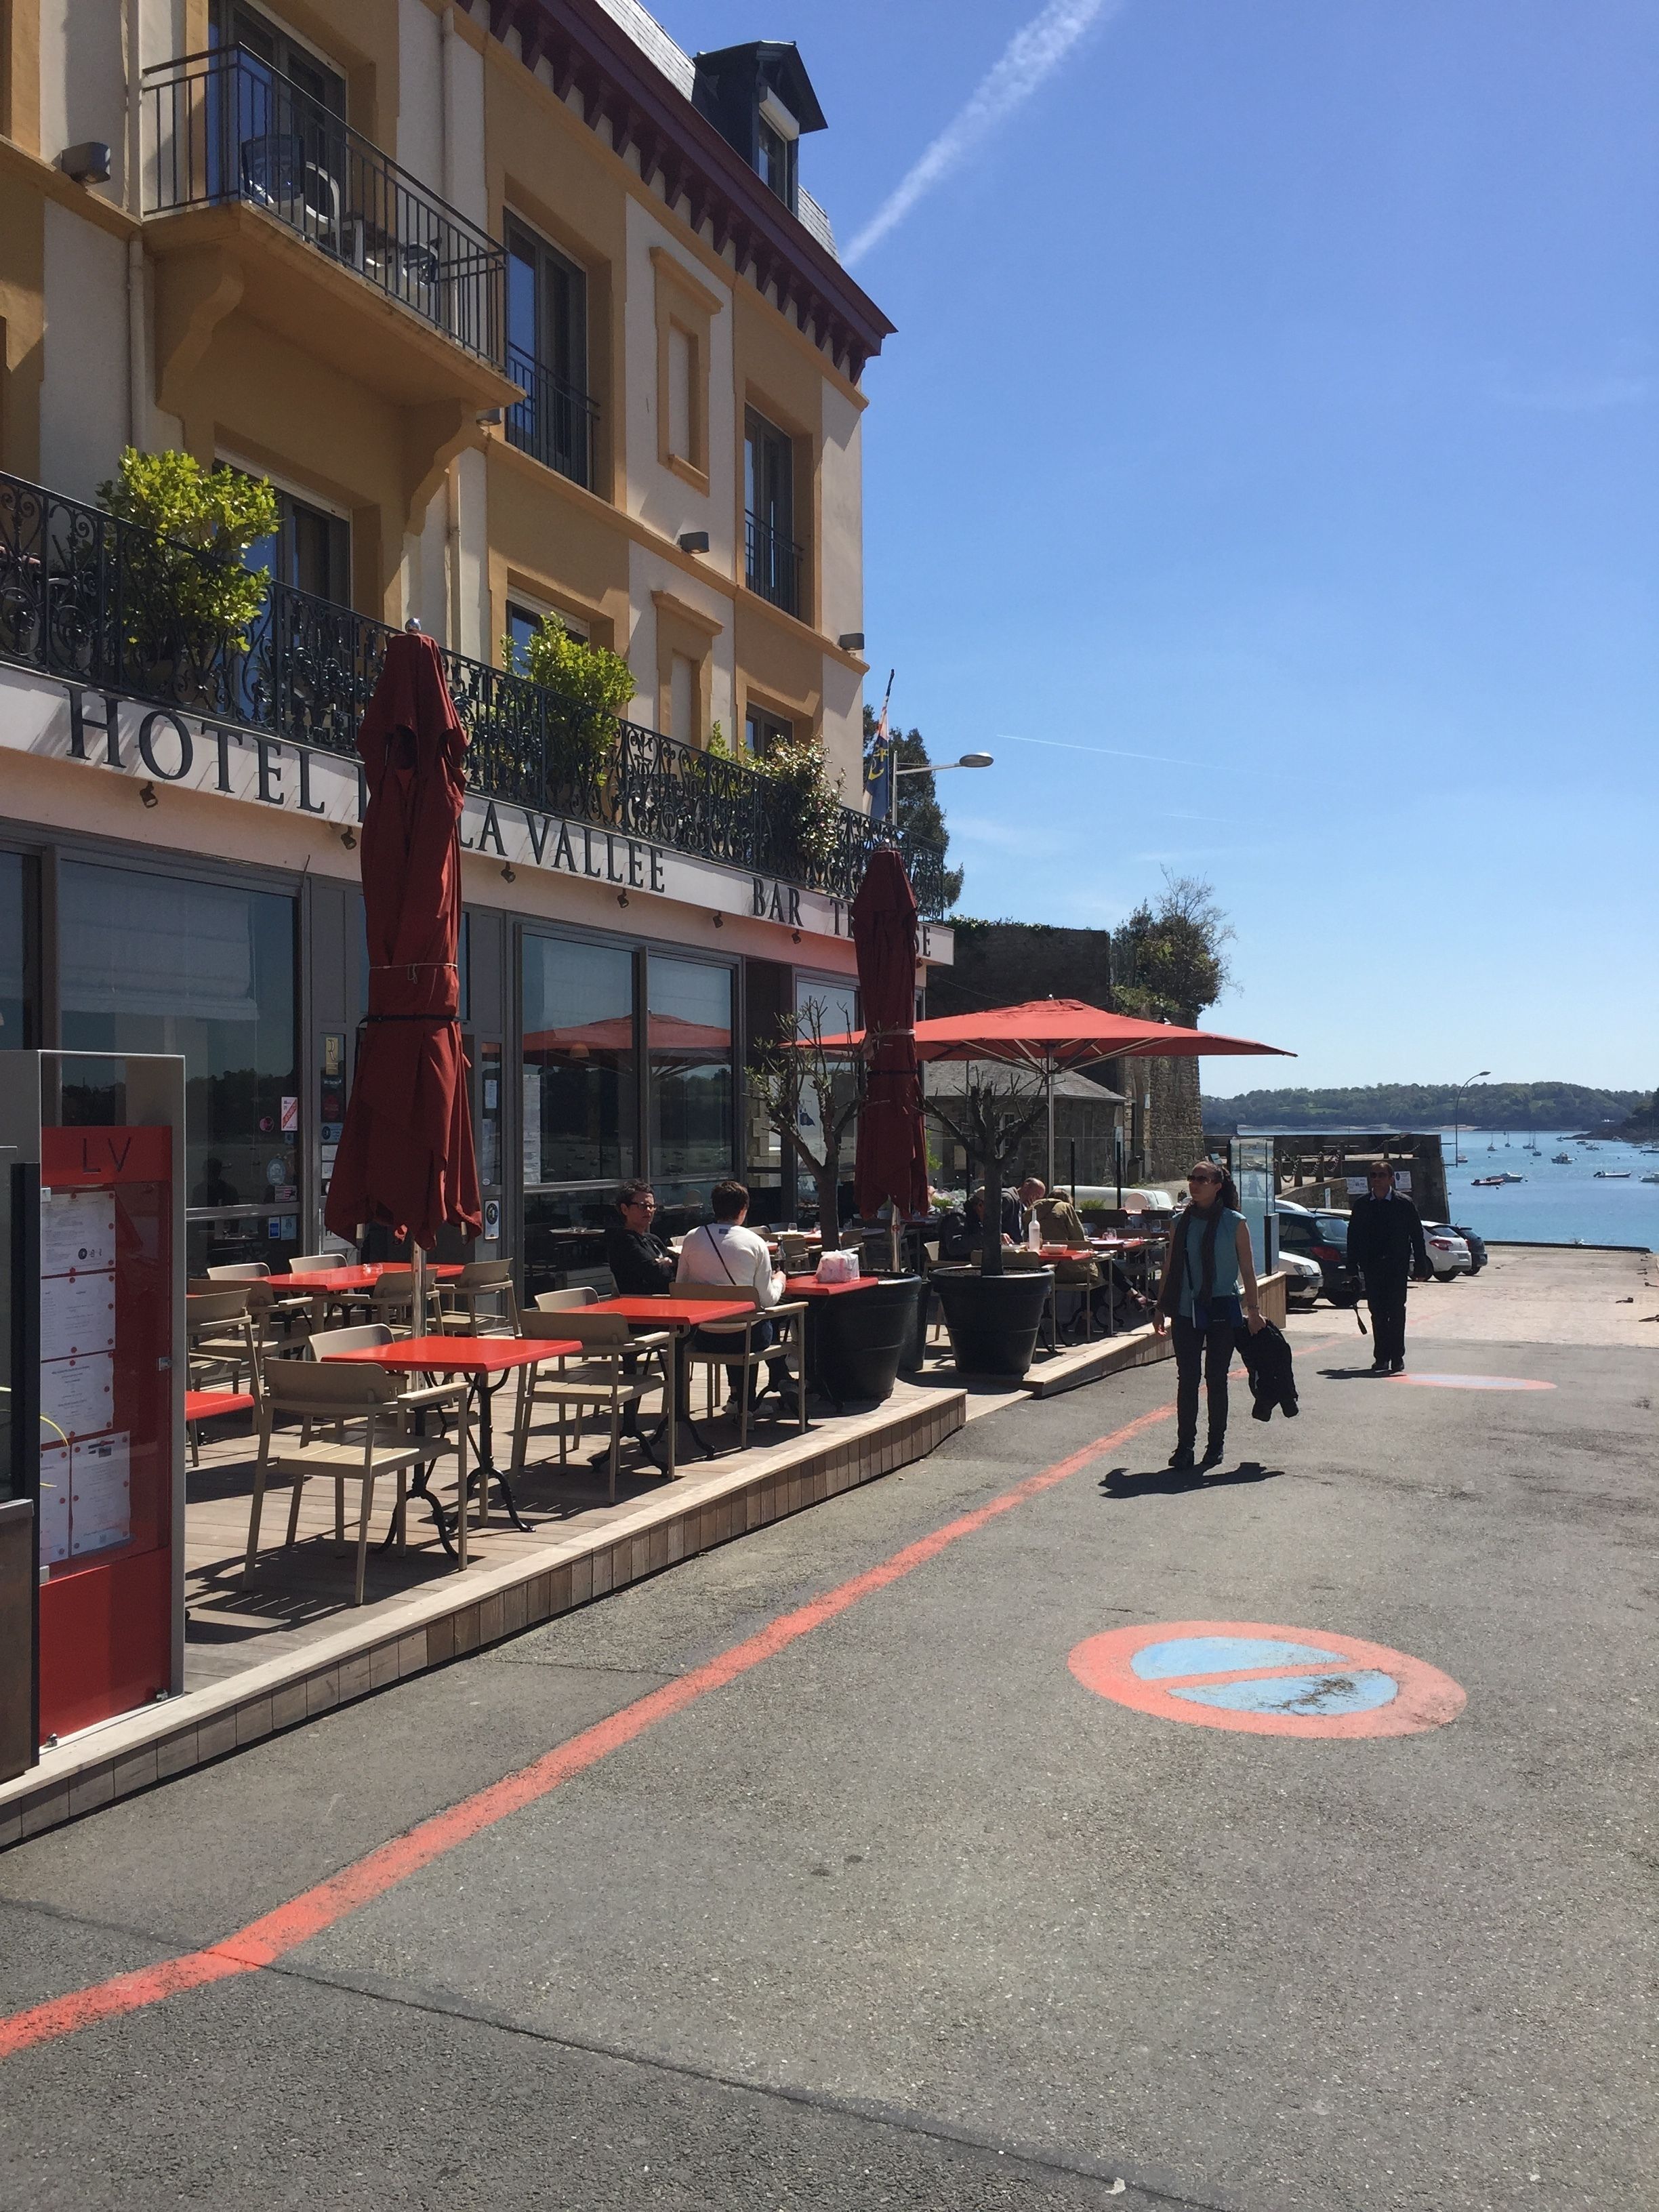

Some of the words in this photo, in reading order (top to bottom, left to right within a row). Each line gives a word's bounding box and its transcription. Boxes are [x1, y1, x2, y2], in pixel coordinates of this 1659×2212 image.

[62, 685, 325, 813] HOTEL
[523, 811, 665, 893] VALLEE
[752, 877, 804, 927] BAR
[82, 1136, 131, 1173] LV
